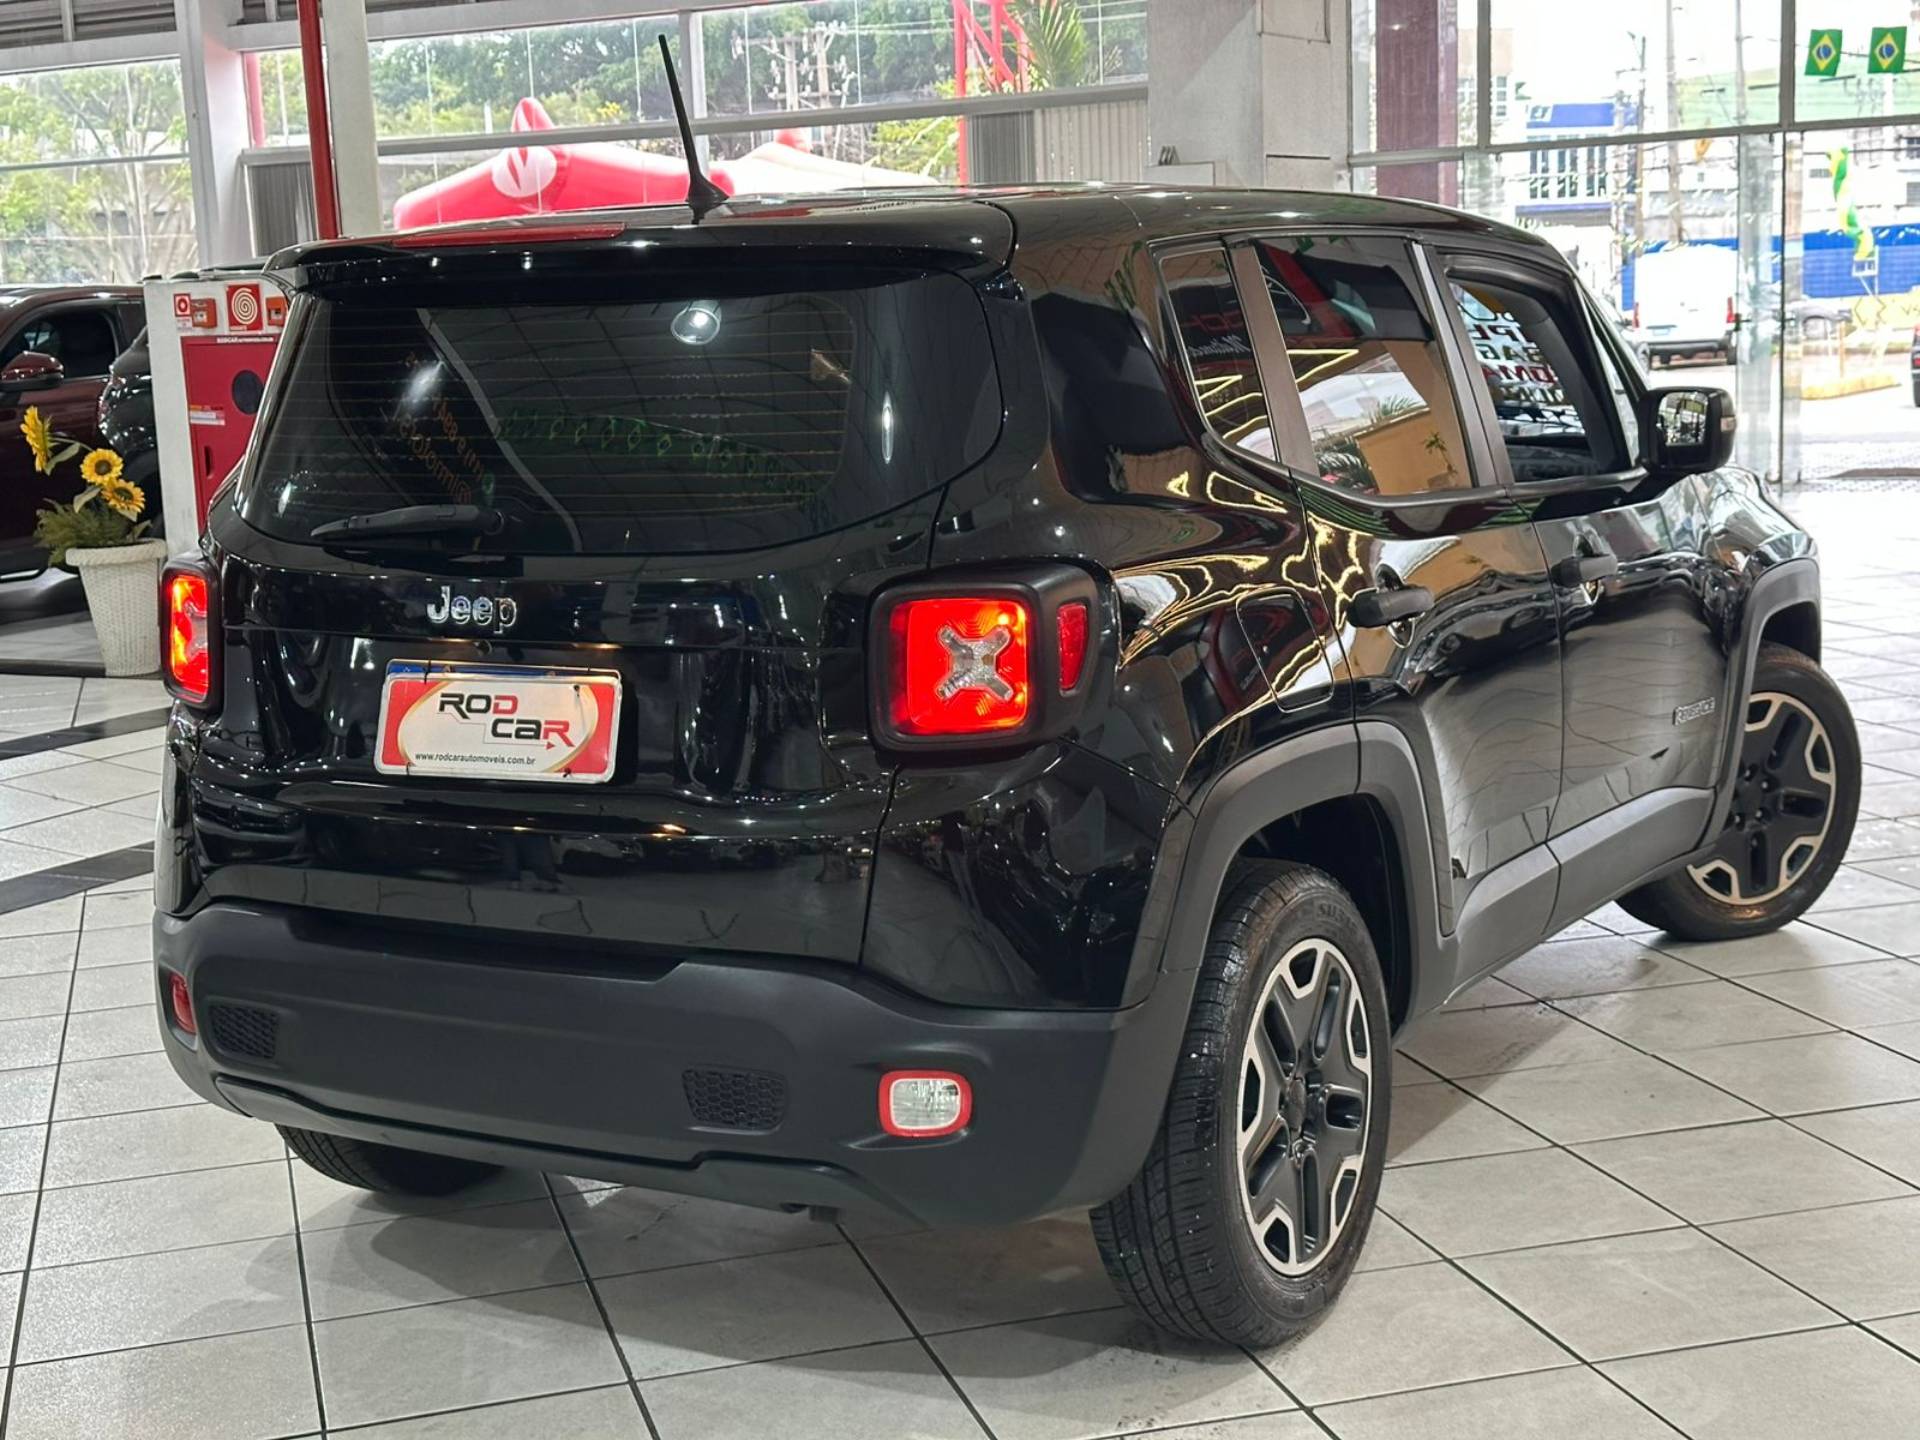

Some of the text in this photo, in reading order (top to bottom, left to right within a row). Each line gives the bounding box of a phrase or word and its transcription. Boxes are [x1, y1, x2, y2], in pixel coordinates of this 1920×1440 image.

[426, 585, 518, 633] Jeep
[438, 692, 518, 720] ROD
[414, 751, 537, 766] www.rodcarautomoveis.com.br
